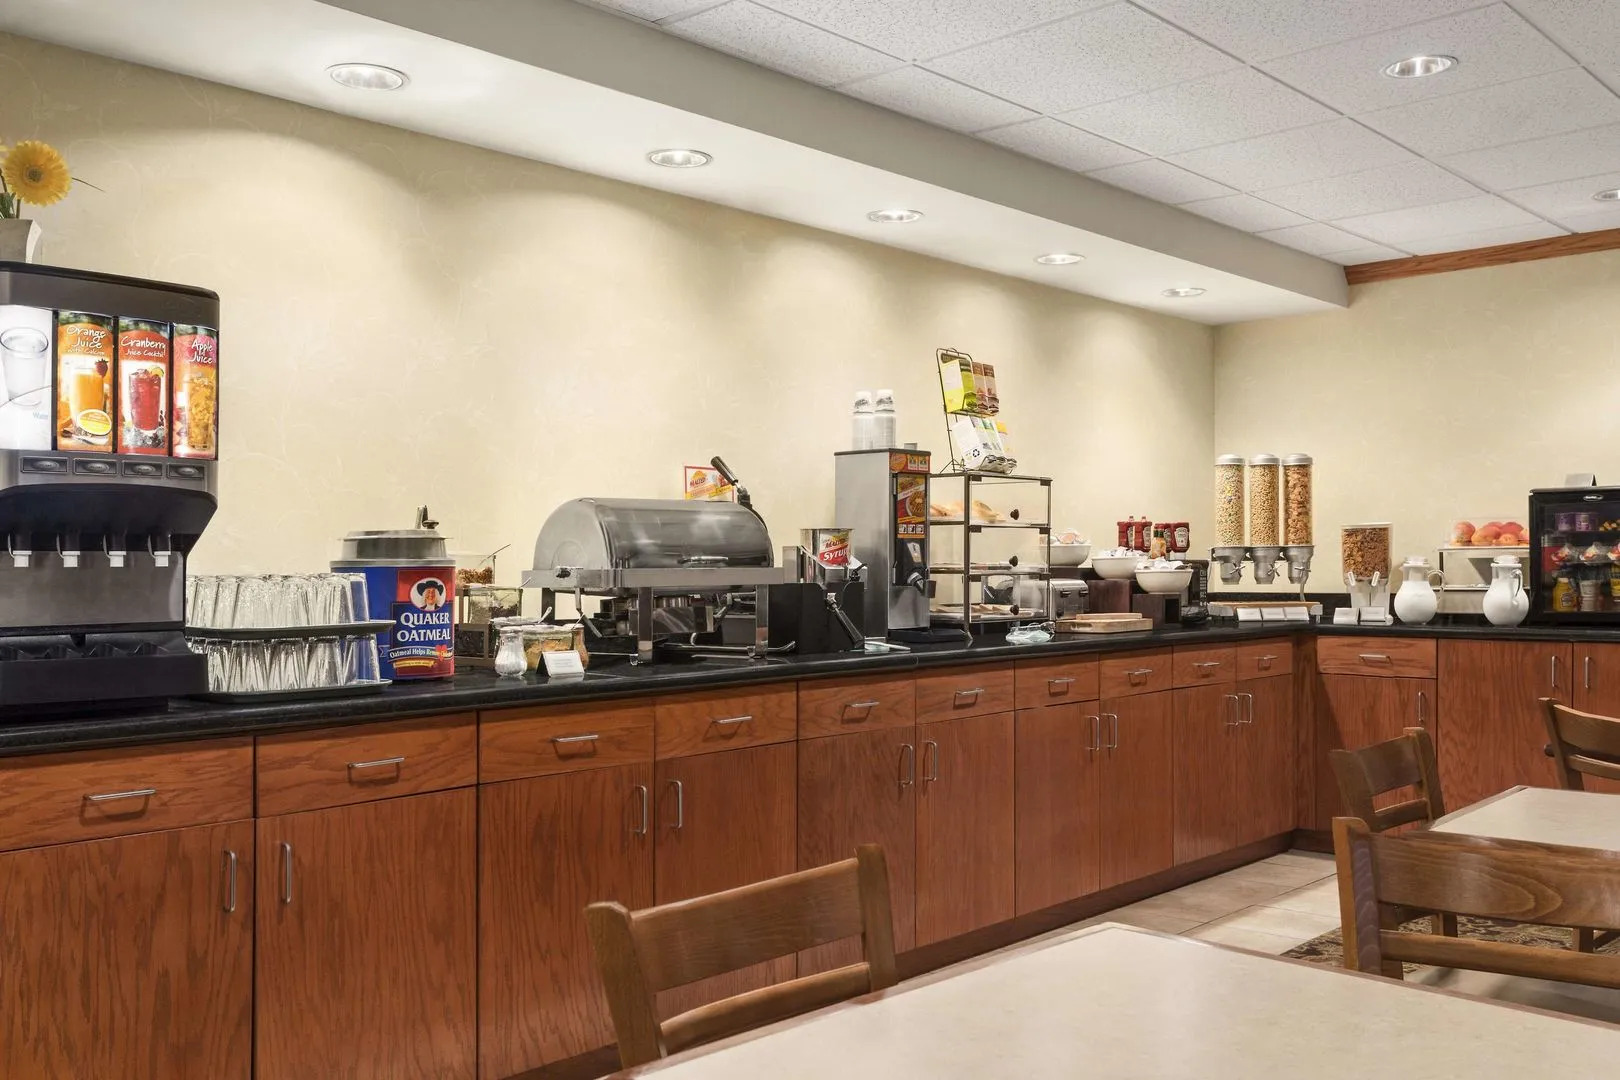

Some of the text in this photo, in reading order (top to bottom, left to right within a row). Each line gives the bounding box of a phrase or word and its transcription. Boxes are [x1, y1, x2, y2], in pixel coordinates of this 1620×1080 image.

[66, 325, 107, 343] Orange
[72, 336, 103, 349] Juice
[120, 335, 167, 356] Cranberry
[191, 339, 213, 355] Apple
[189, 350, 213, 364] Juice
[400, 612, 450, 628] QUAKER
[396, 629, 451, 642] OATMEAL
[390, 649, 411, 658] Oatmeal
